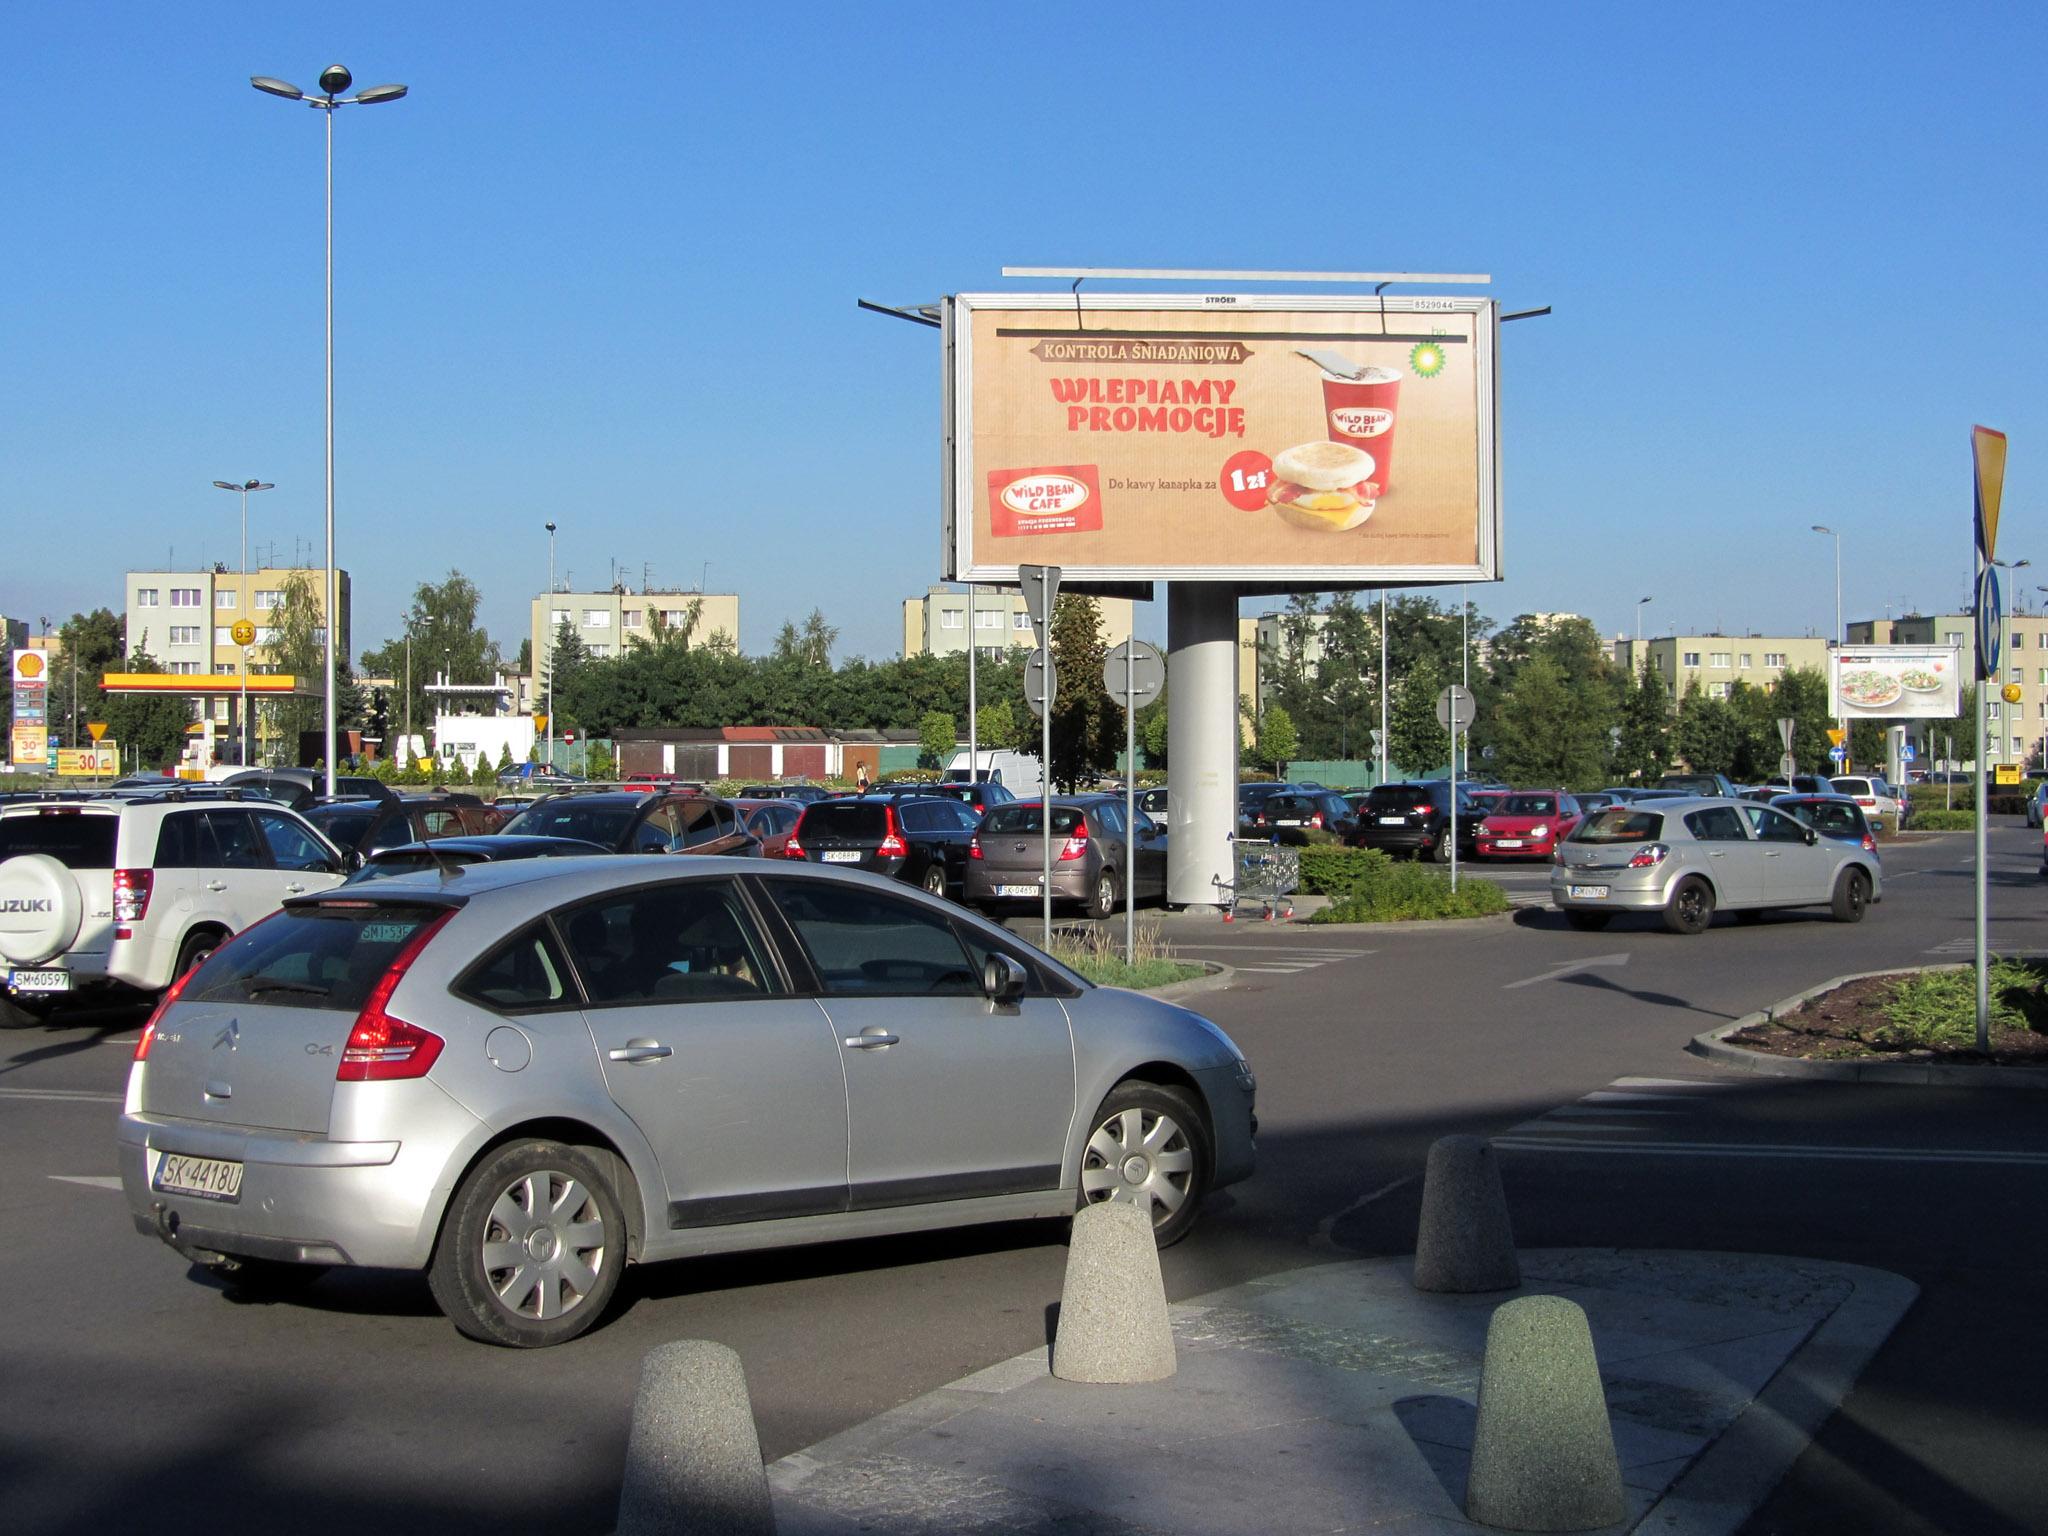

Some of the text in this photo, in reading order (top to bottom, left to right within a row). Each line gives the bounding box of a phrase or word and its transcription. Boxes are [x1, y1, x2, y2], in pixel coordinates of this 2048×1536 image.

[1044, 342, 1240, 362] KONTROLA ŚNIADANIOWA
[1050, 378, 1236, 404] WLEPIAMY
[1067, 406, 1246, 439] PROMOCJĘ
[1363, 413, 1386, 424] BEAN
[1347, 425, 1375, 434] CAFE
[1109, 479, 1124, 490] Do
[1126, 478, 1155, 492] kawy
[1158, 478, 1202, 492] kanapka
[1205, 481, 1217, 490] za
[1230, 469, 1245, 492] 1
[1046, 483, 1075, 497] BEAN
[1028, 498, 1062, 510] CAFE
[236, 627, 252, 639] B3
[79, 755, 96, 770] 30
[164, 1157, 188, 1185] SK
[191, 1161, 242, 1193] 4418U
